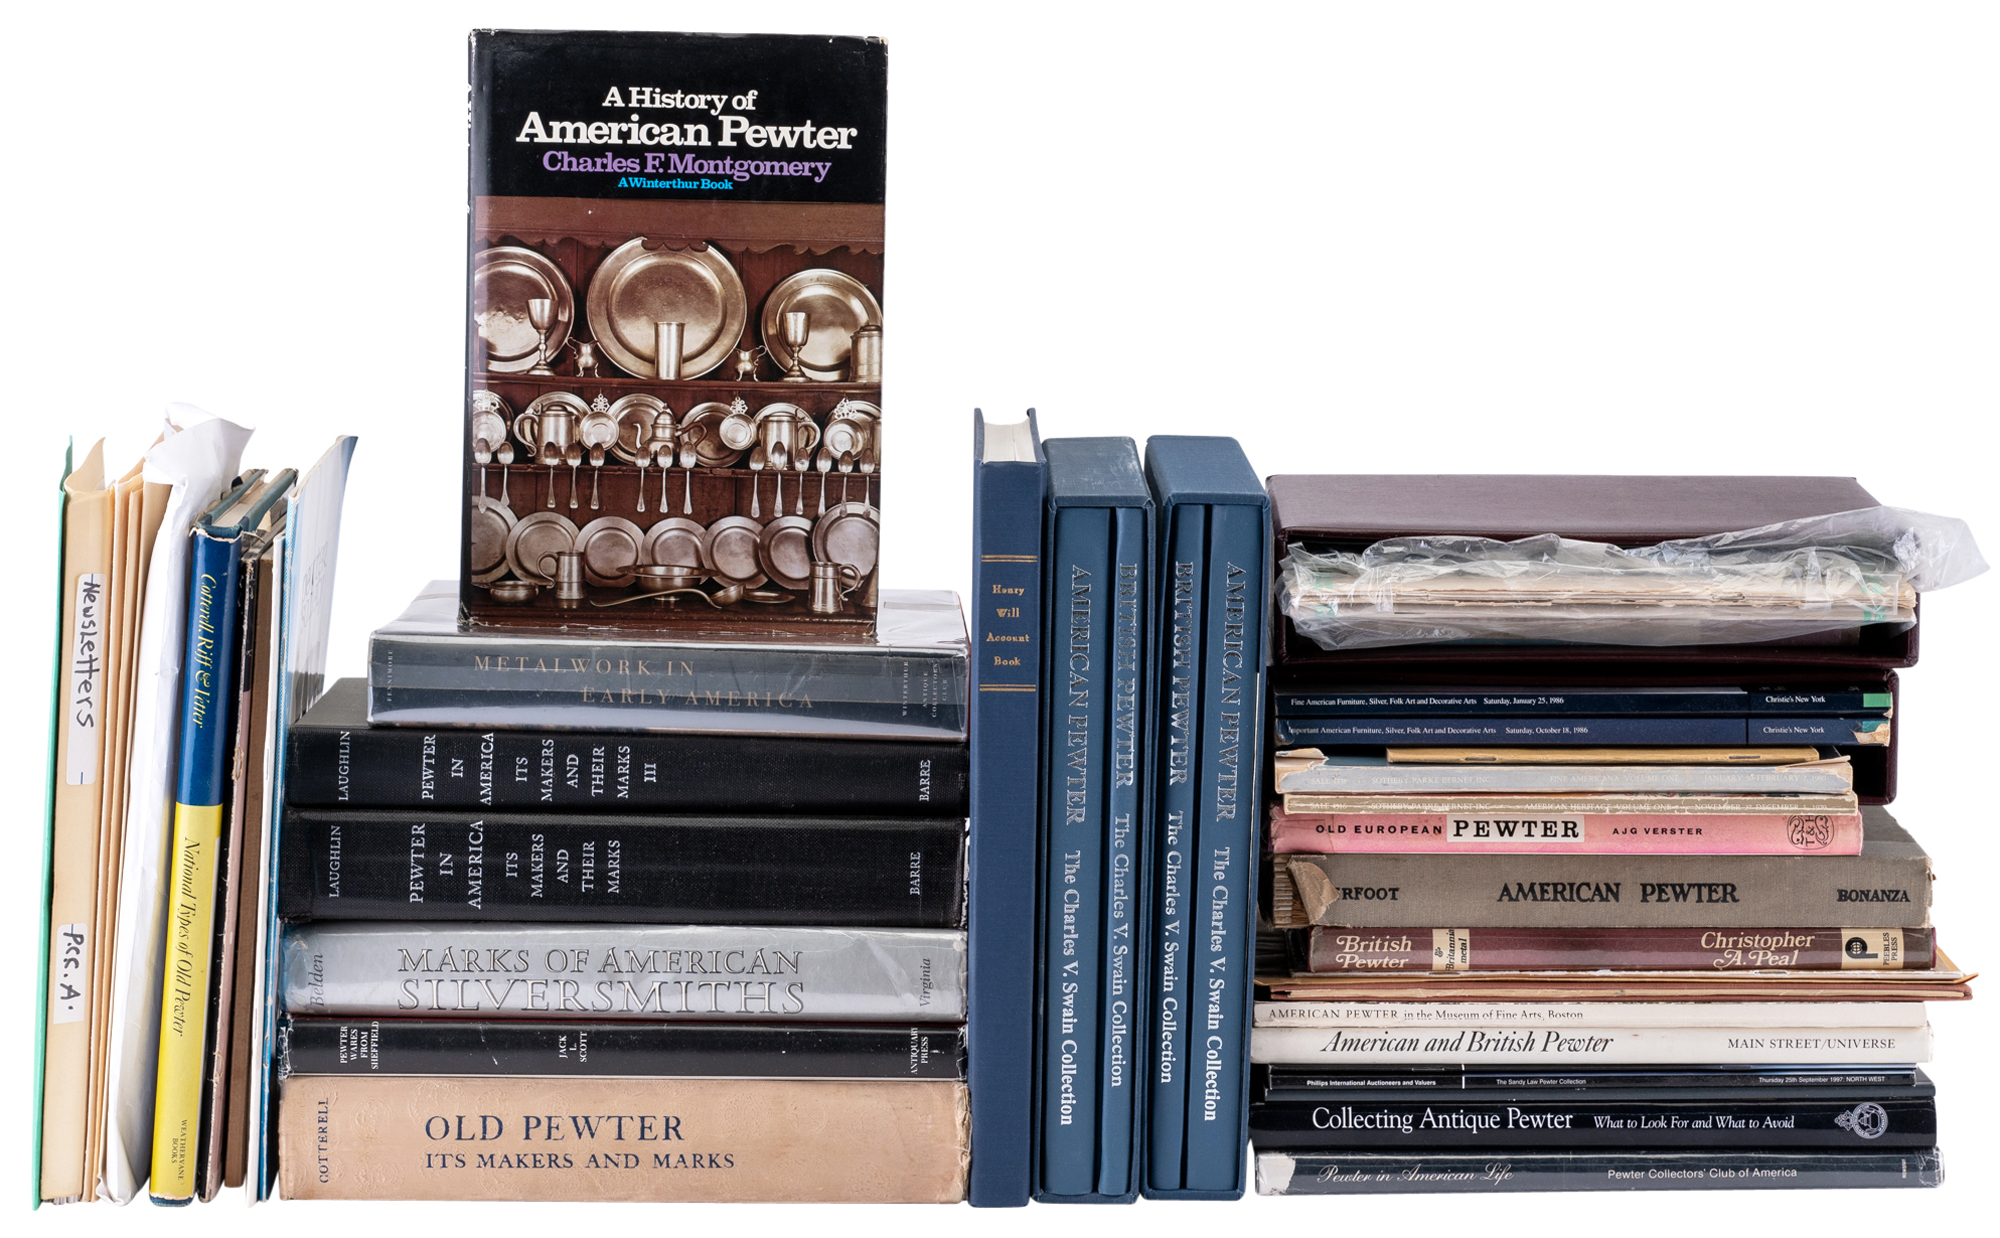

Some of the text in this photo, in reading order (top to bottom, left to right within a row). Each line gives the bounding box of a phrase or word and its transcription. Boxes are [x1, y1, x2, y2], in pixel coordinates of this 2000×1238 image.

[602, 86, 758, 115] A History of
[516, 112, 857, 150] American Pewter
[543, 151, 831, 182] Charles F. Montgomery
[628, 177, 733, 190] Winterthur Book
[992, 584, 1025, 597] Henry
[996, 606, 1020, 618] Will
[985, 631, 1030, 643] Account
[74, 581, 101, 728] Newsletters
[473, 656, 694, 676] METALWORK IN
[993, 655, 1021, 666] Book
[193, 635, 214, 728] Riff Vetter
[1116, 562, 1137, 789] BRITISH PEWTER
[1170, 561, 1194, 785] BRITISH PEWTER
[582, 686, 814, 709] EARLY AMERICA
[1067, 565, 1091, 825] AMERICAN PEWTER
[1216, 562, 1246, 822] AMERICAN PEWTER
[1765, 695, 1826, 703] Christie's New York
[1320, 726, 1352, 734] American
[1352, 726, 1384, 735] Furniture,
[1385, 726, 1406, 735] Silver,
[1406, 726, 1422, 734] Folk
[1447, 726, 1482, 734] Decorative
[1505, 726, 1589, 736] Saturday, October 1986
[1762, 726, 1825, 734] Christie's New York
[338, 730, 351, 801] LAUGHLIN
[421, 734, 436, 800] PEWTER
[450, 757, 464, 778] IN
[479, 732, 494, 806] AMERICA
[515, 756, 529, 782] ITS
[540, 739, 555, 802] MAKERS
[566, 753, 579, 789] AND
[591, 746, 605, 797] THEIR
[616, 745, 631, 799] MARKS
[643, 762, 657, 783] III
[918, 759, 931, 802] BARRE
[1315, 824, 1442, 836] OLD EUROPEAN
[1453, 820, 1578, 838] PEWTER
[1612, 826, 1703, 836] AJG VERSTER
[328, 825, 342, 898] LAUGHLIN
[410, 823, 425, 903] PEWTER
[439, 851, 454, 876] IN
[468, 819, 483, 909] AMERICA
[505, 852, 519, 878] ITS
[530, 833, 545, 898] MAKERS
[556, 848, 569, 884] AND
[581, 840, 595, 893] THEIR
[607, 839, 621, 894] MARKS
[909, 851, 921, 896] BARRE
[1497, 882, 1740, 903] AMERICAN PEWTER
[1836, 888, 1911, 903] BONANZA
[172, 837, 200, 1037] National Types Old Pewter
[1112, 813, 1129, 1087] The Charles Swain Collection
[1161, 811, 1183, 1083] The Charles Swain Collection
[1336, 936, 1411, 952] British
[1444, 928, 1456, 971] Britannia
[1458, 937, 1468, 964] metal
[1701, 932, 1815, 952] Christopher
[398, 946, 803, 974] MARKS OF AMERICAN
[1713, 950, 1798, 967] A. Peal
[308, 954, 324, 1006] Belden
[919, 958, 933, 1007] Virginia
[1061, 850, 1080, 1125] The Charles Swain Collection
[1205, 847, 1230, 1121] The Charles Swain Collection
[398, 978, 805, 1014] SILVERSMITHS
[1269, 1008, 1398, 1019] AMERICAN PEWTER
[338, 1024, 348, 1064] PEWTER
[350, 1028, 358, 1061] WARES
[360, 1031, 369, 1059] FROM
[370, 1020, 380, 1070] SHEFFIELD
[558, 1035, 569, 1059] JACK
[579, 1031, 588, 1063] SCOTT
[920, 1036, 929, 1064] PRESS
[1320, 1031, 1614, 1053] American and British Pewter
[1728, 1038, 1897, 1049] MAIN STREET/UNIVERSE
[426, 1115, 684, 1140] OLD PEWTER
[1313, 1107, 1573, 1134] Collecting Antique Pewter
[1593, 1114, 1795, 1129] What Look For and What Avoid
[317, 1097, 329, 1184] COTTERELL
[427, 1154, 734, 1168] ITS MAKERS AND MARKS
[1317, 1163, 1514, 1185] Pewter American Life
[1607, 1167, 1798, 1181] Pewter Collectors' Club America
